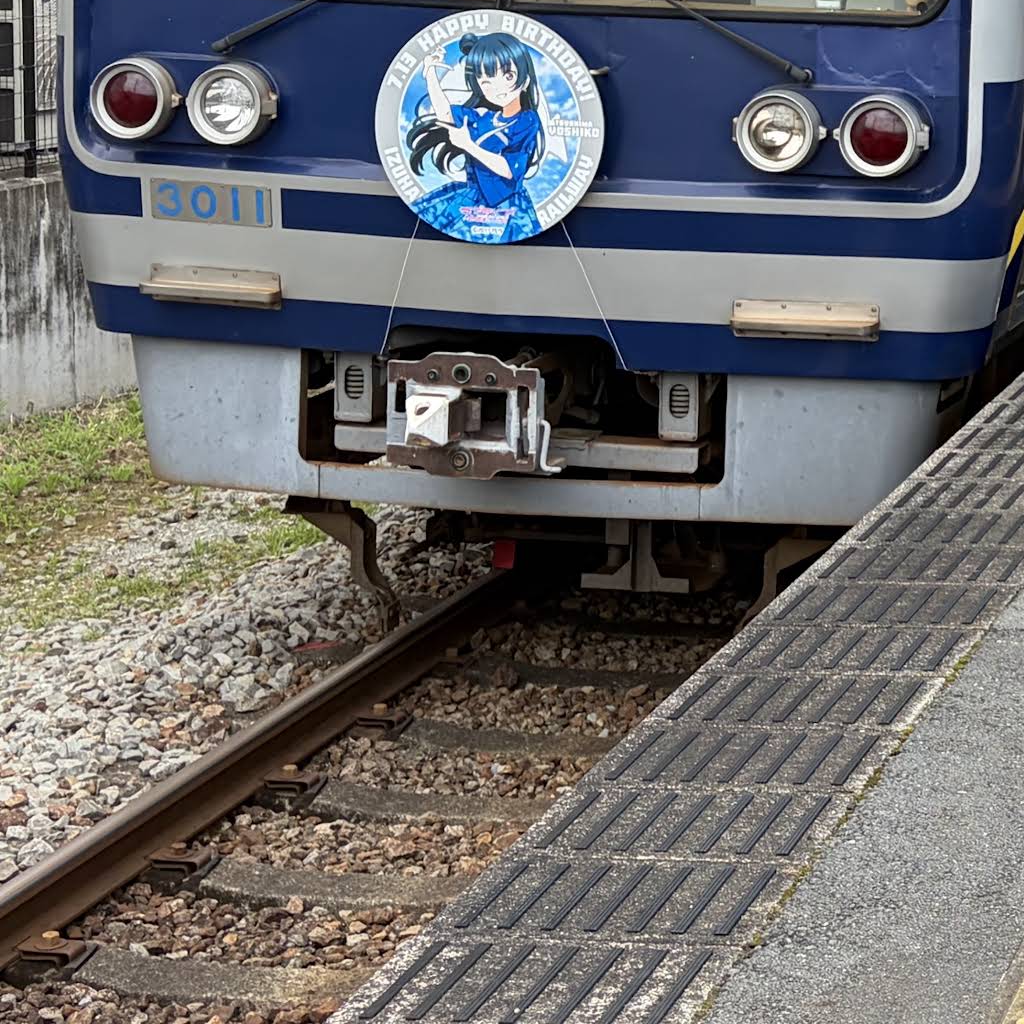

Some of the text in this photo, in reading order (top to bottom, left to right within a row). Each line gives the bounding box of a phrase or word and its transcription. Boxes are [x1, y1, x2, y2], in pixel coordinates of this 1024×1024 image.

[387, 13, 596, 102] 7.13 HAPPY BIRTHDAY!
[547, 126, 601, 139] YOSHIKO
[157, 182, 265, 225] 3011
[535, 153, 596, 226] RAILWAY
